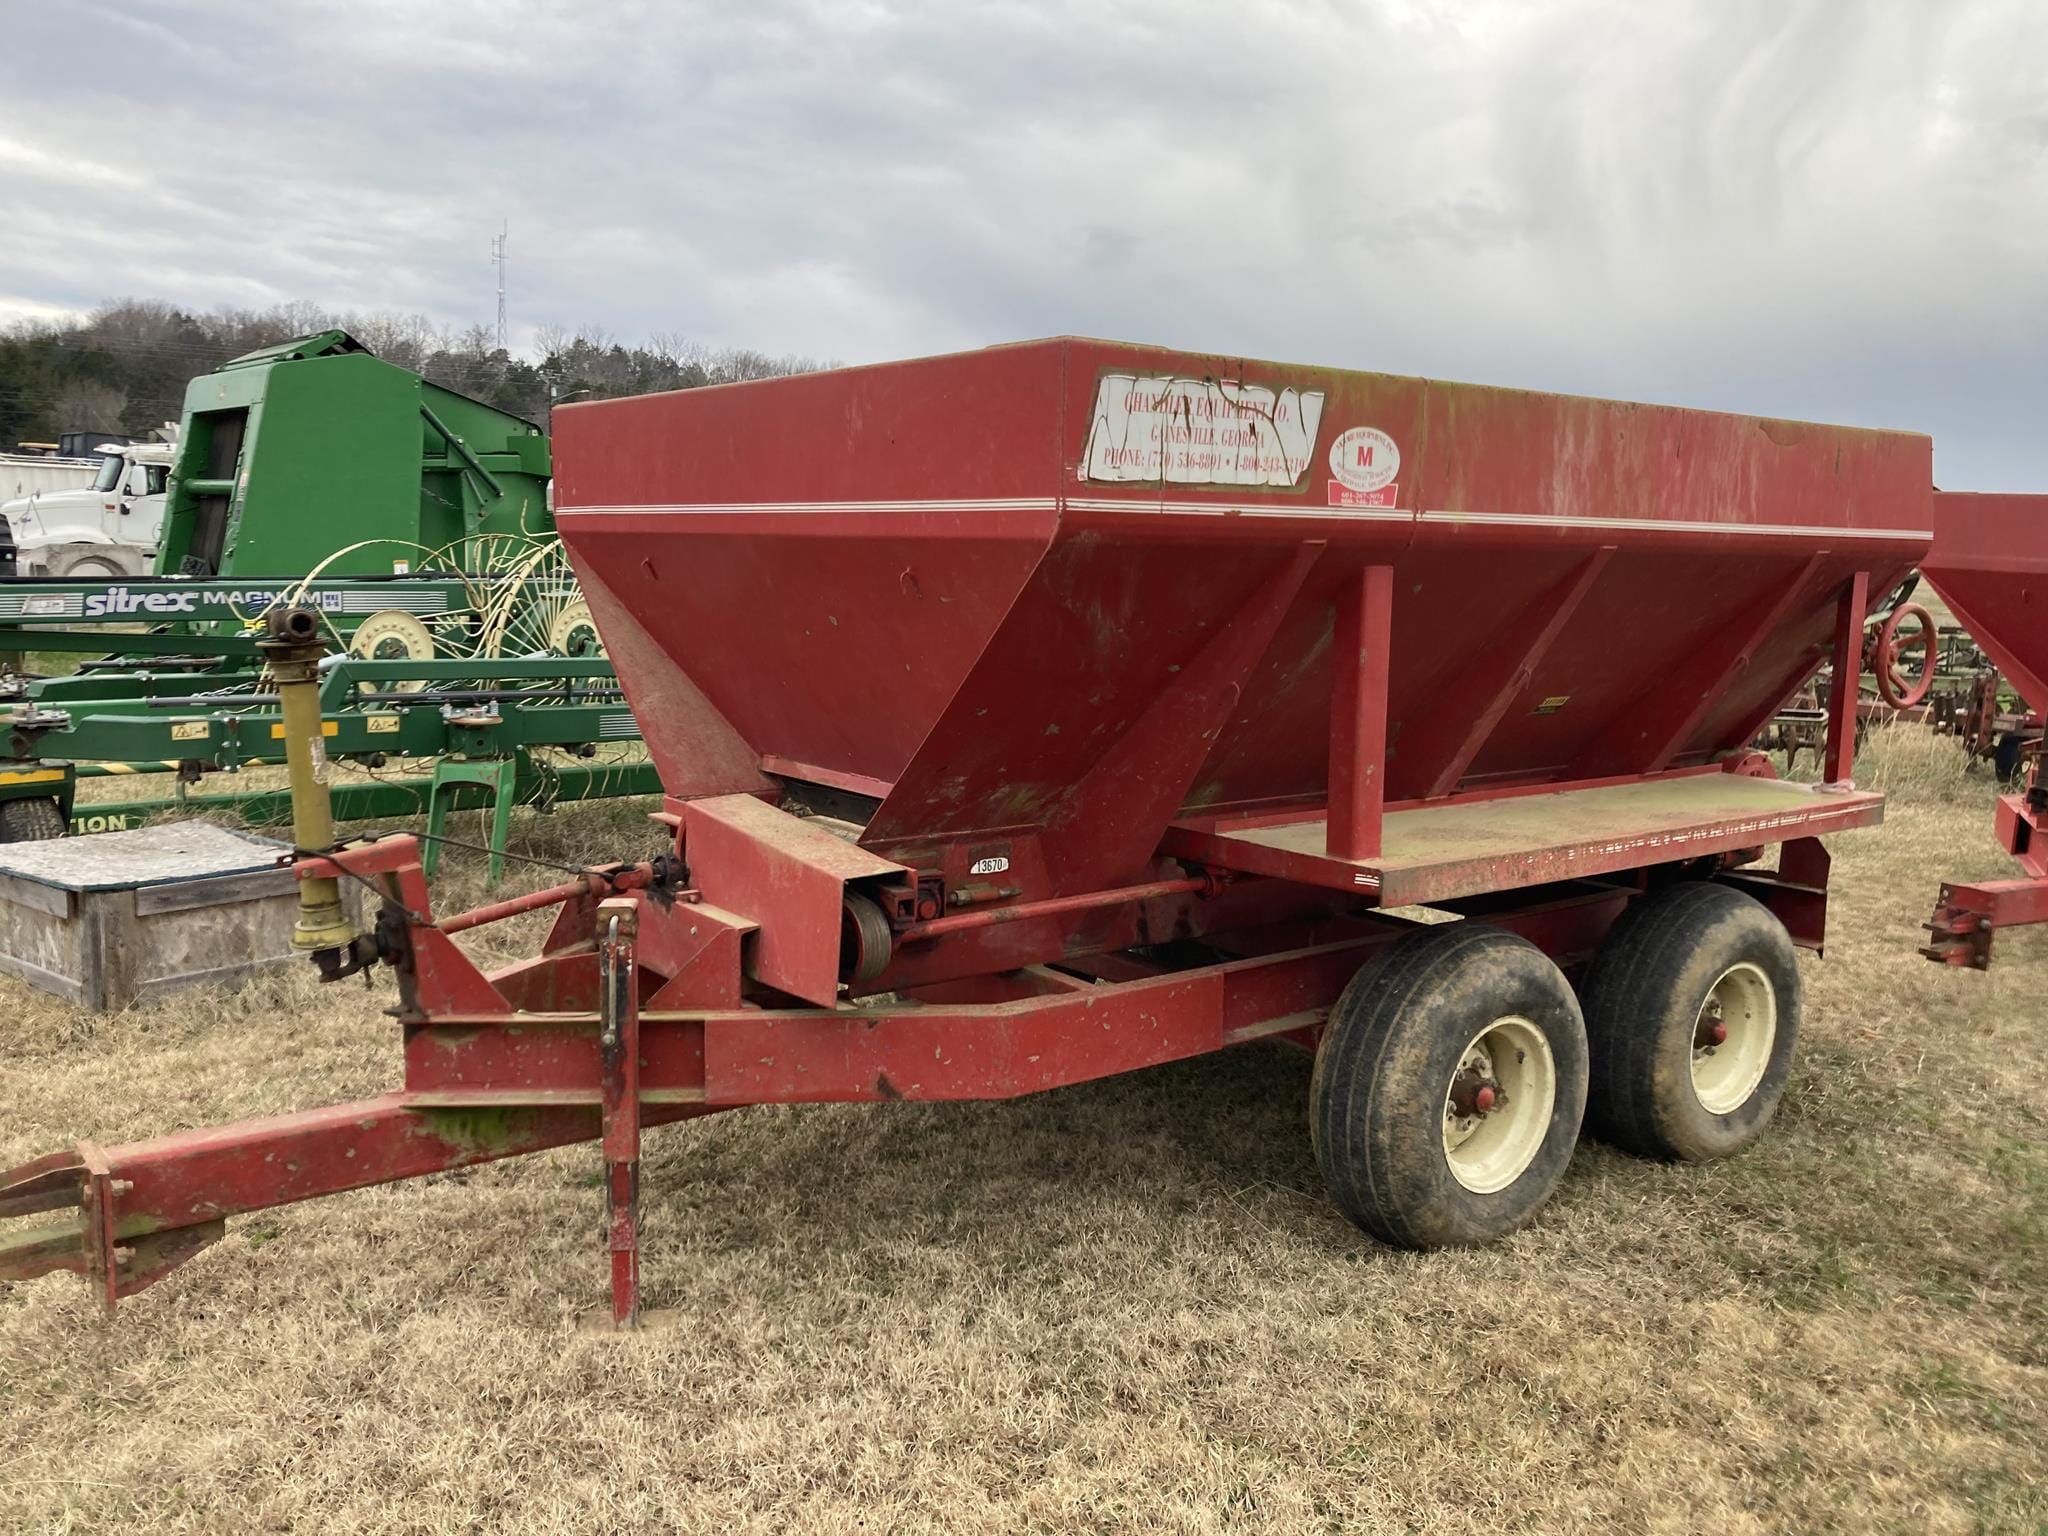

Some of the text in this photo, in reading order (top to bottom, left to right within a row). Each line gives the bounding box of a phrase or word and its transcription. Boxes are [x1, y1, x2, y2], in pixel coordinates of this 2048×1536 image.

[1357, 446, 1373, 467] M
[85, 587, 199, 617] sitrex
[203, 591, 321, 605] MAGNUM
